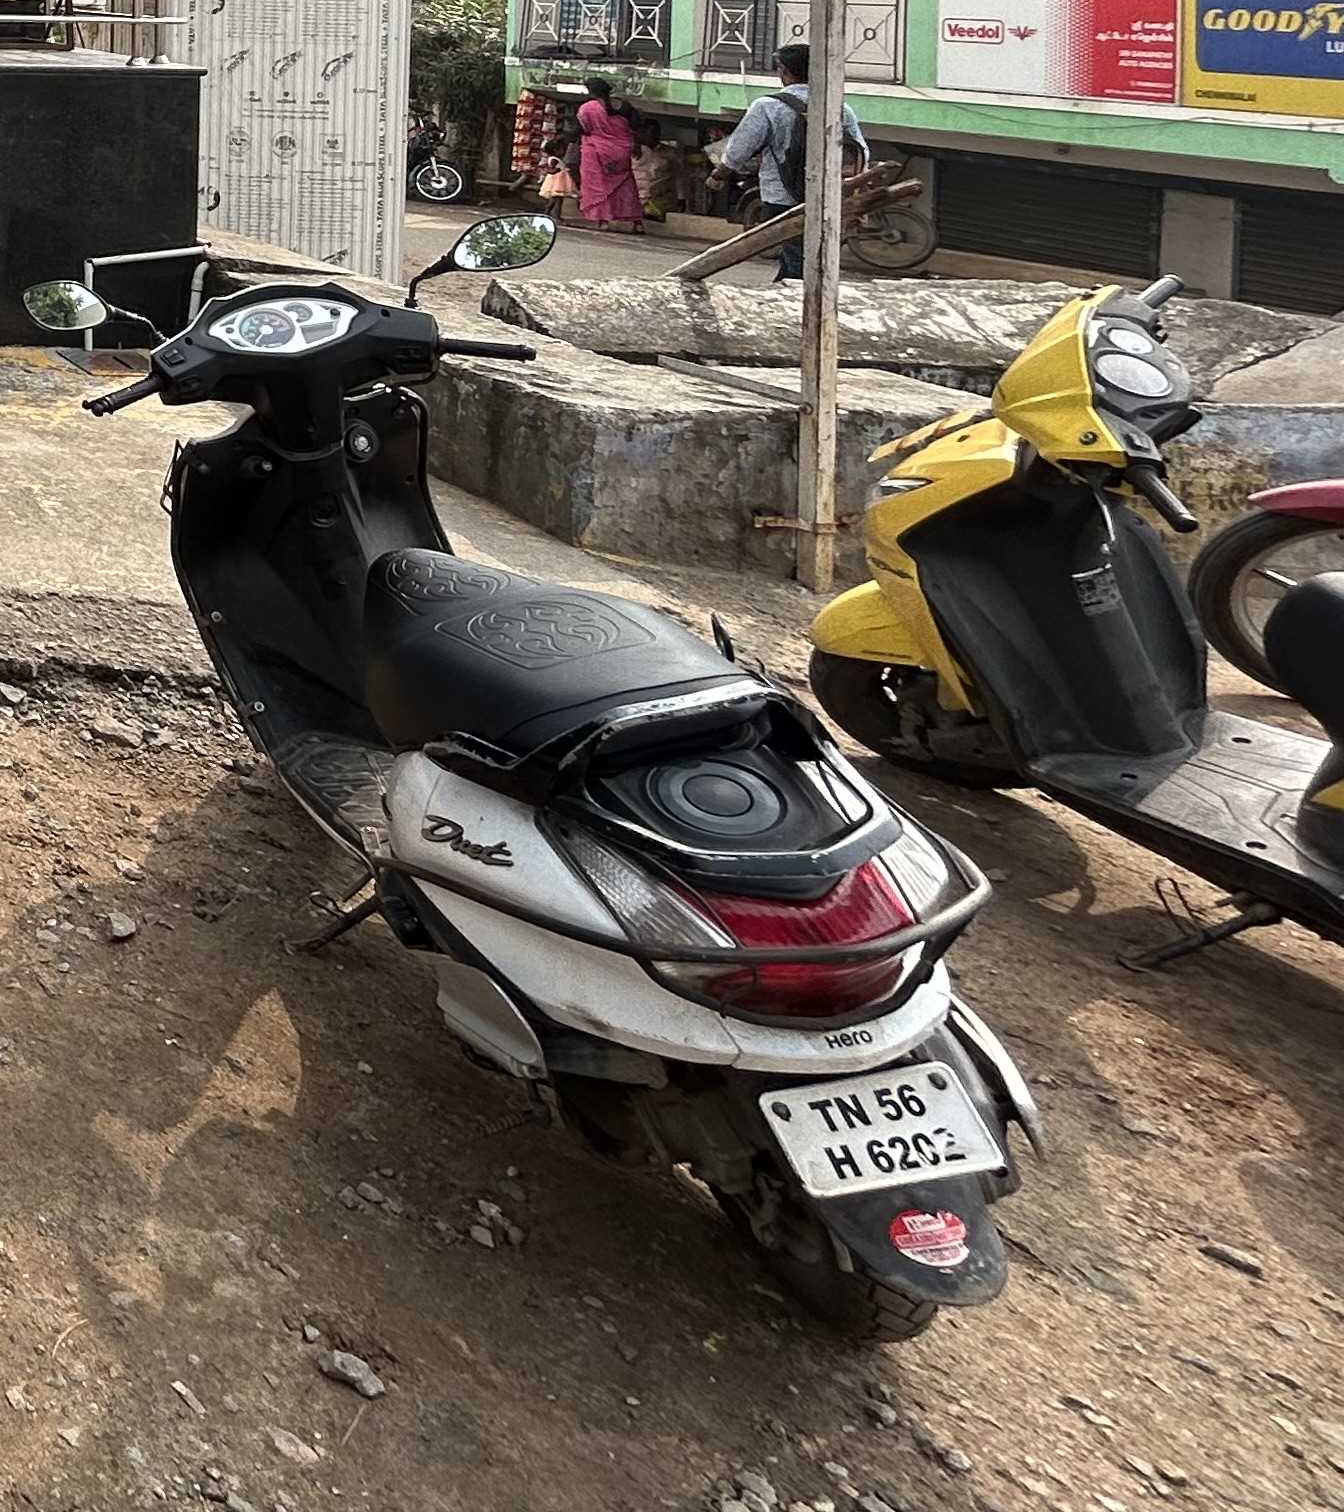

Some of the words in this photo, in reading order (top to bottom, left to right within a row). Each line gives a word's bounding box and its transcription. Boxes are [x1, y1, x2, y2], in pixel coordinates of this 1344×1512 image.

[947, 22, 1000, 39] Veedol
[420, 814, 514, 868] Duet
[823, 1026, 874, 1052] Hero
[808, 1094, 873, 1133] TN
[875, 1083, 926, 1122] 56
[824, 1145, 864, 1180] H
